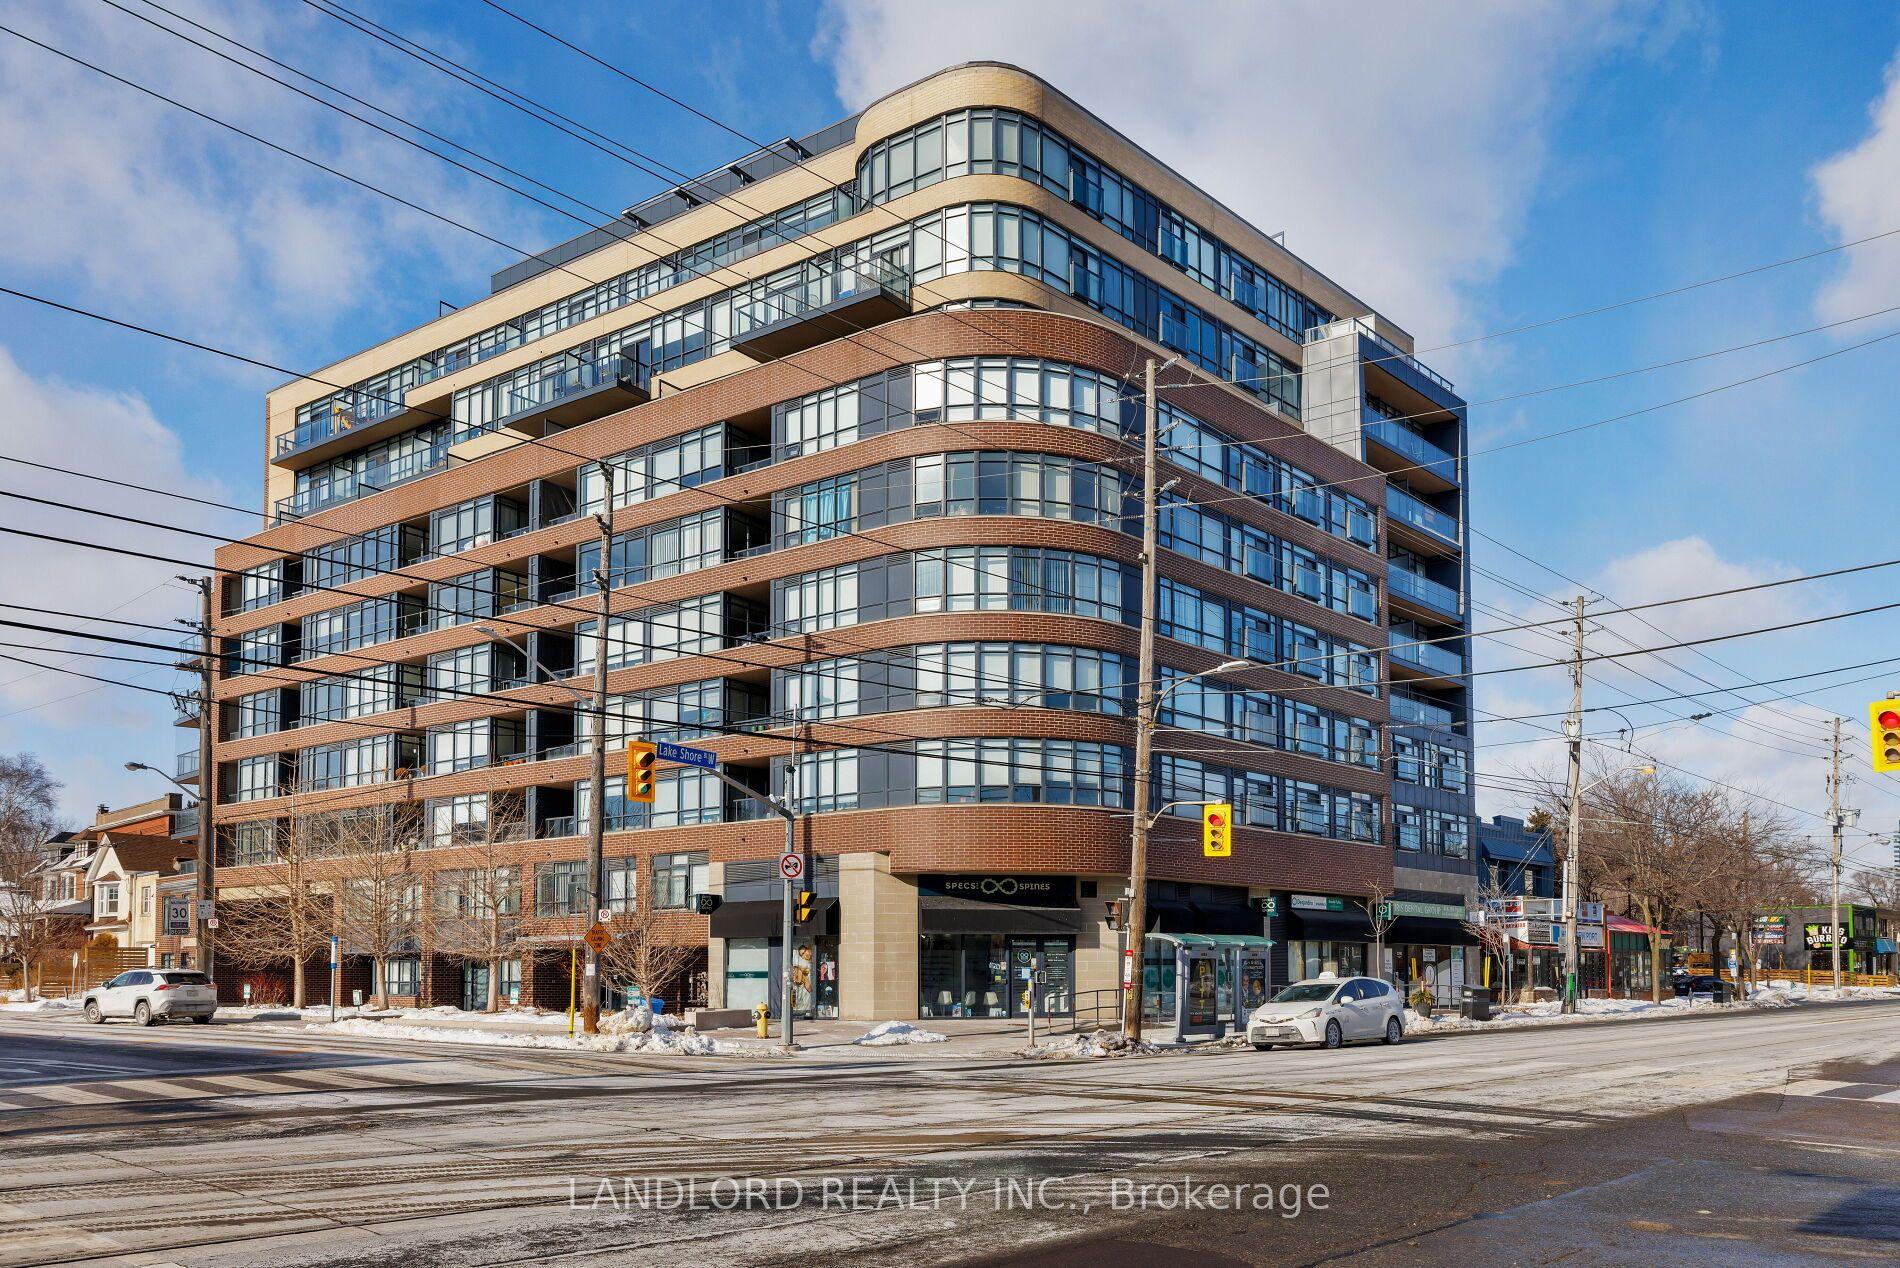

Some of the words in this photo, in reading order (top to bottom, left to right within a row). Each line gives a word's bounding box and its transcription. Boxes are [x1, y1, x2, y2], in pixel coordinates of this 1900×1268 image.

[659, 744, 677, 757] Lake
[680, 748, 702, 762] Shore
[708, 753, 714, 764] W
[172, 908, 187, 918] 30
[1405, 904, 1423, 913] DENTAL
[1425, 905, 1441, 914] GROUP
[1821, 925, 1845, 935] KIG
